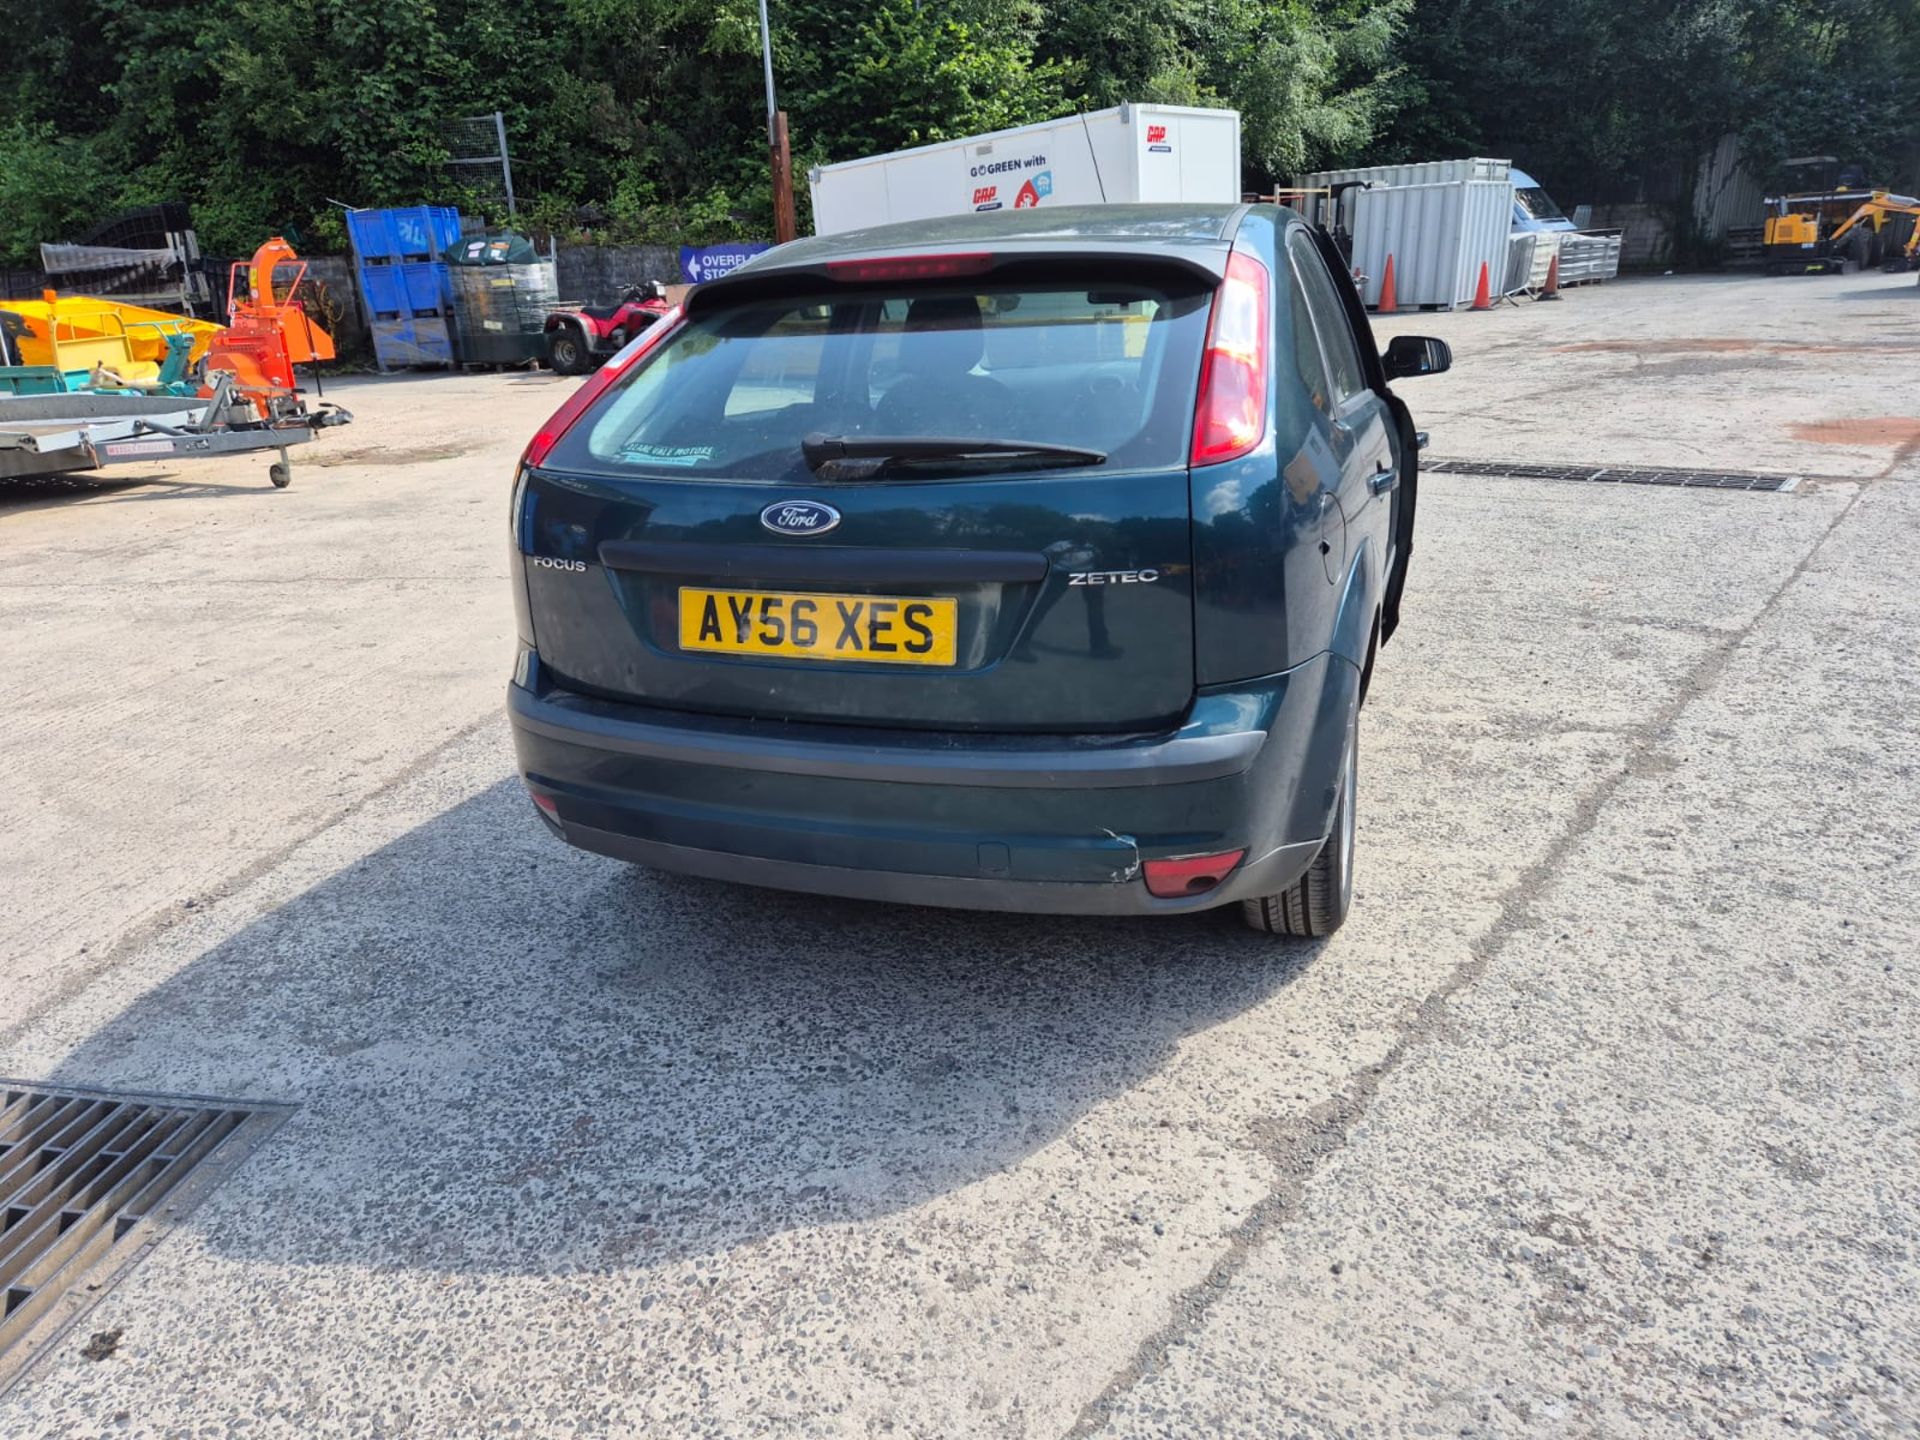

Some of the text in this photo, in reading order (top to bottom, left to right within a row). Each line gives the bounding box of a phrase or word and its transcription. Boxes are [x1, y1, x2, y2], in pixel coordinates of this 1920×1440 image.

[987, 160, 1021, 175] GREEN
[1023, 154, 1046, 168] with
[702, 254, 757, 267] OVERFL
[777, 506, 819, 527] Ford
[534, 556, 587, 572] FOCUS
[1068, 569, 1159, 586] ZETEC
[699, 594, 935, 654] AY56 XES
